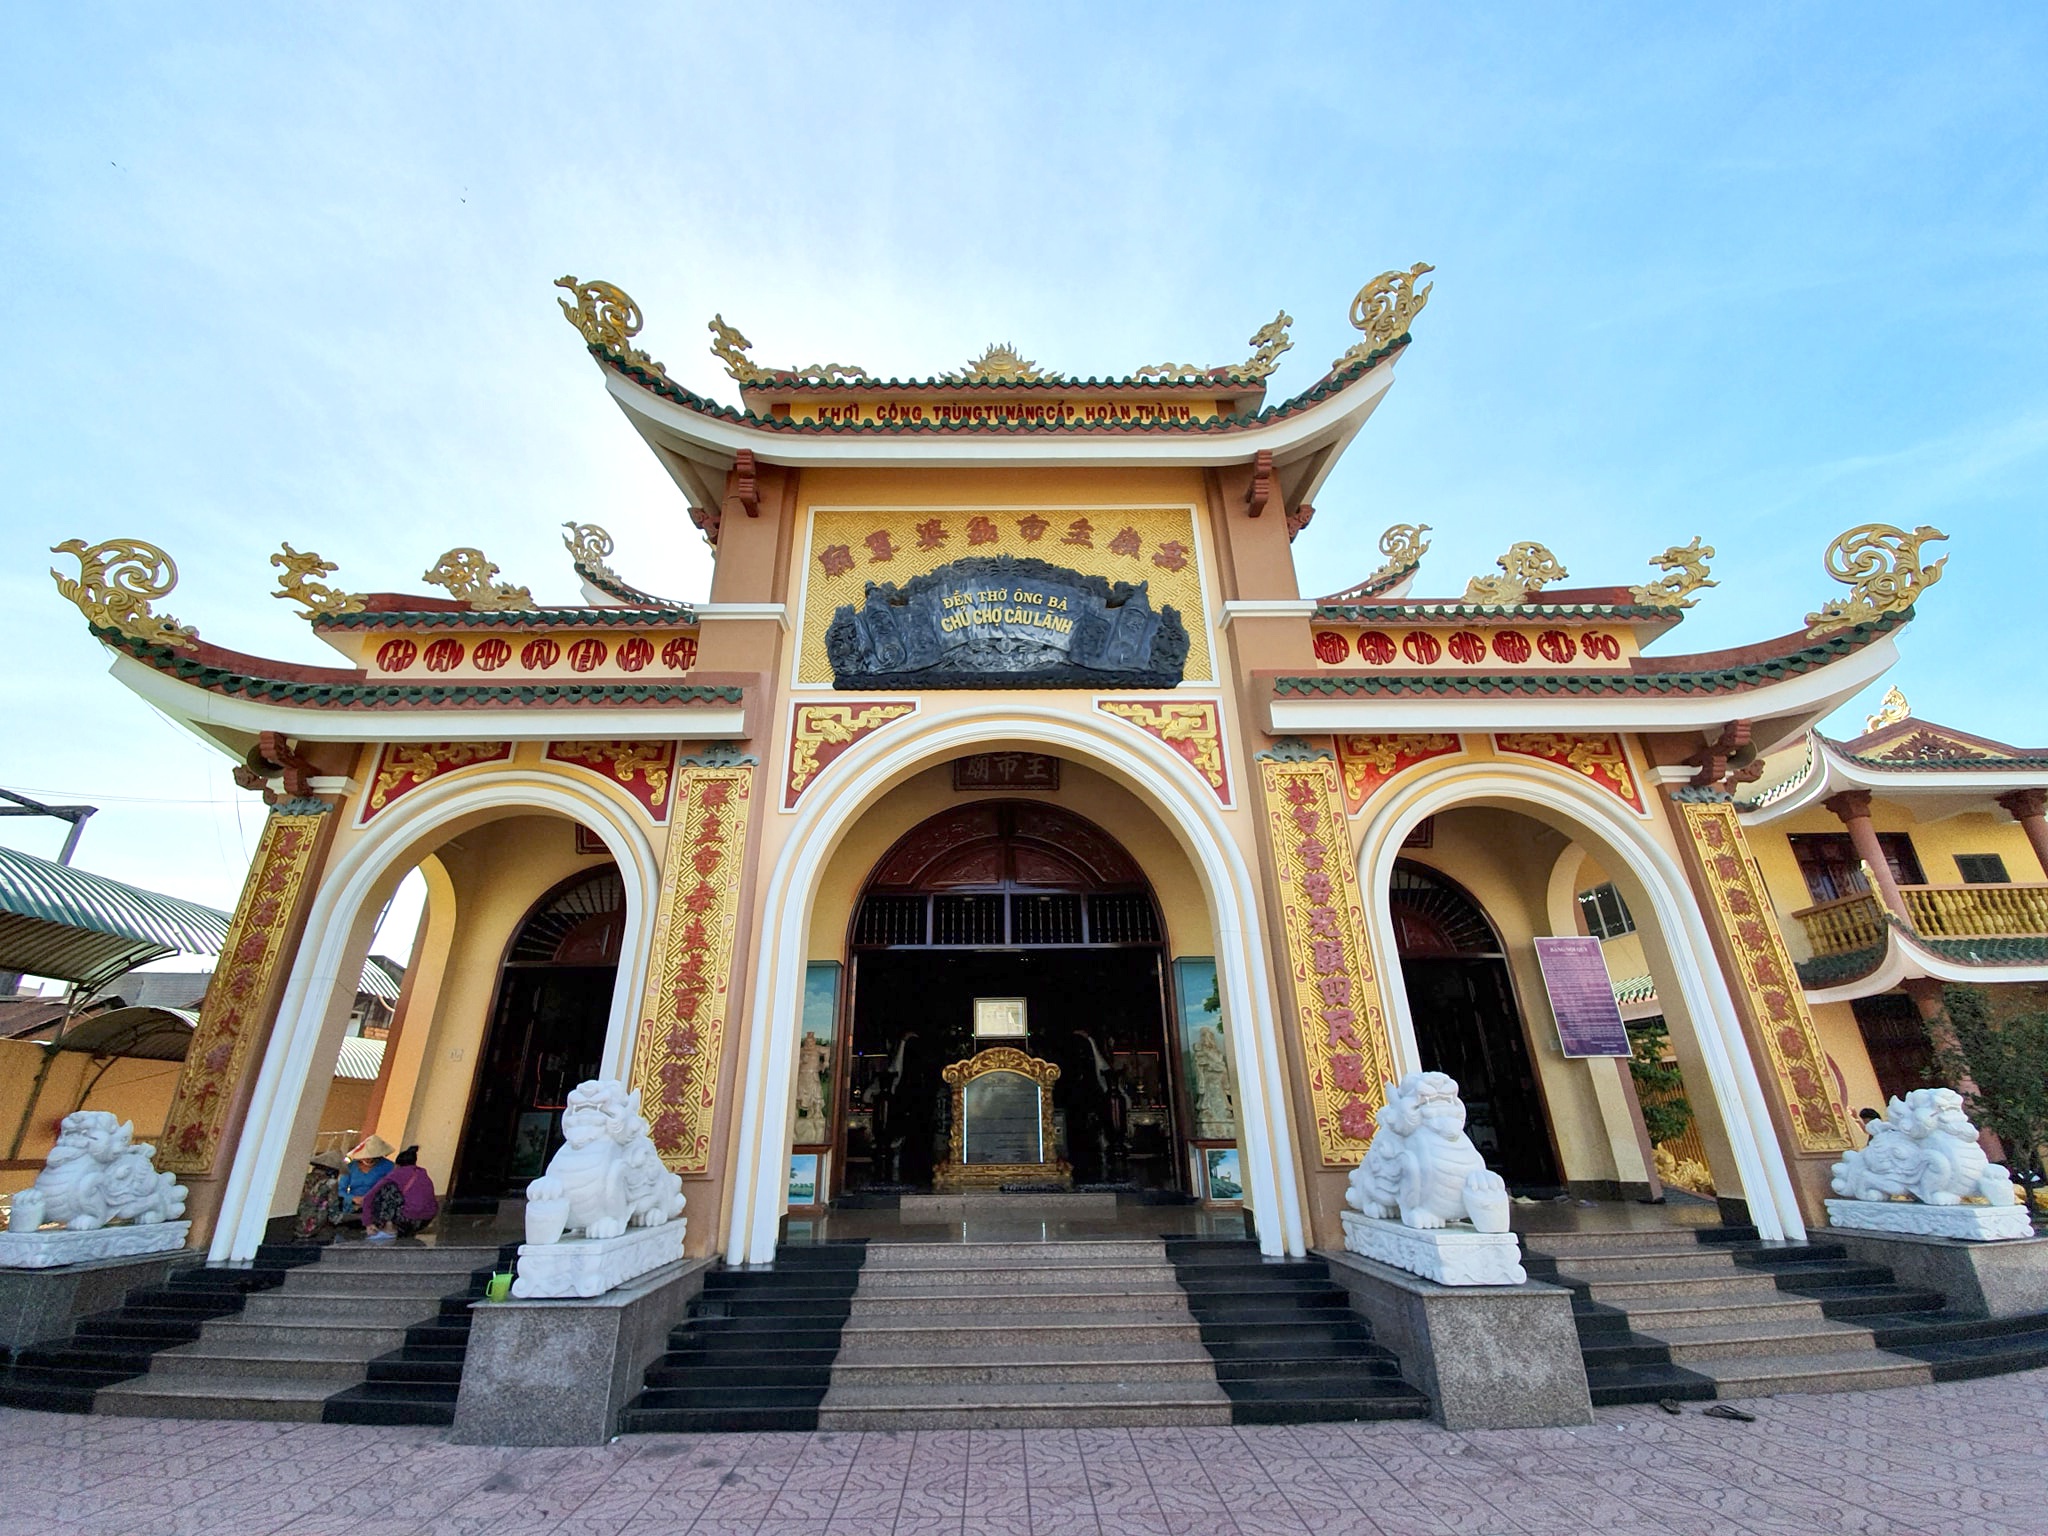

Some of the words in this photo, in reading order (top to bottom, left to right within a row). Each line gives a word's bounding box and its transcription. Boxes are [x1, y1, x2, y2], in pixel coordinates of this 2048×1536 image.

[876, 402, 922, 421] CÔNG
[1085, 402, 1131, 421] HOÀN
[1136, 402, 1190, 421] THÀNH
[942, 589, 973, 609] ĐỀN
[977, 587, 1008, 604] THỜ
[1013, 588, 1043, 605] ÔNG
[1048, 596, 1069, 612] BÀ
[941, 606, 971, 632] CHỦ
[973, 606, 1003, 627] CHỢ
[1004, 606, 1033, 625] CÂU
[1033, 609, 1073, 634] LÃNH
